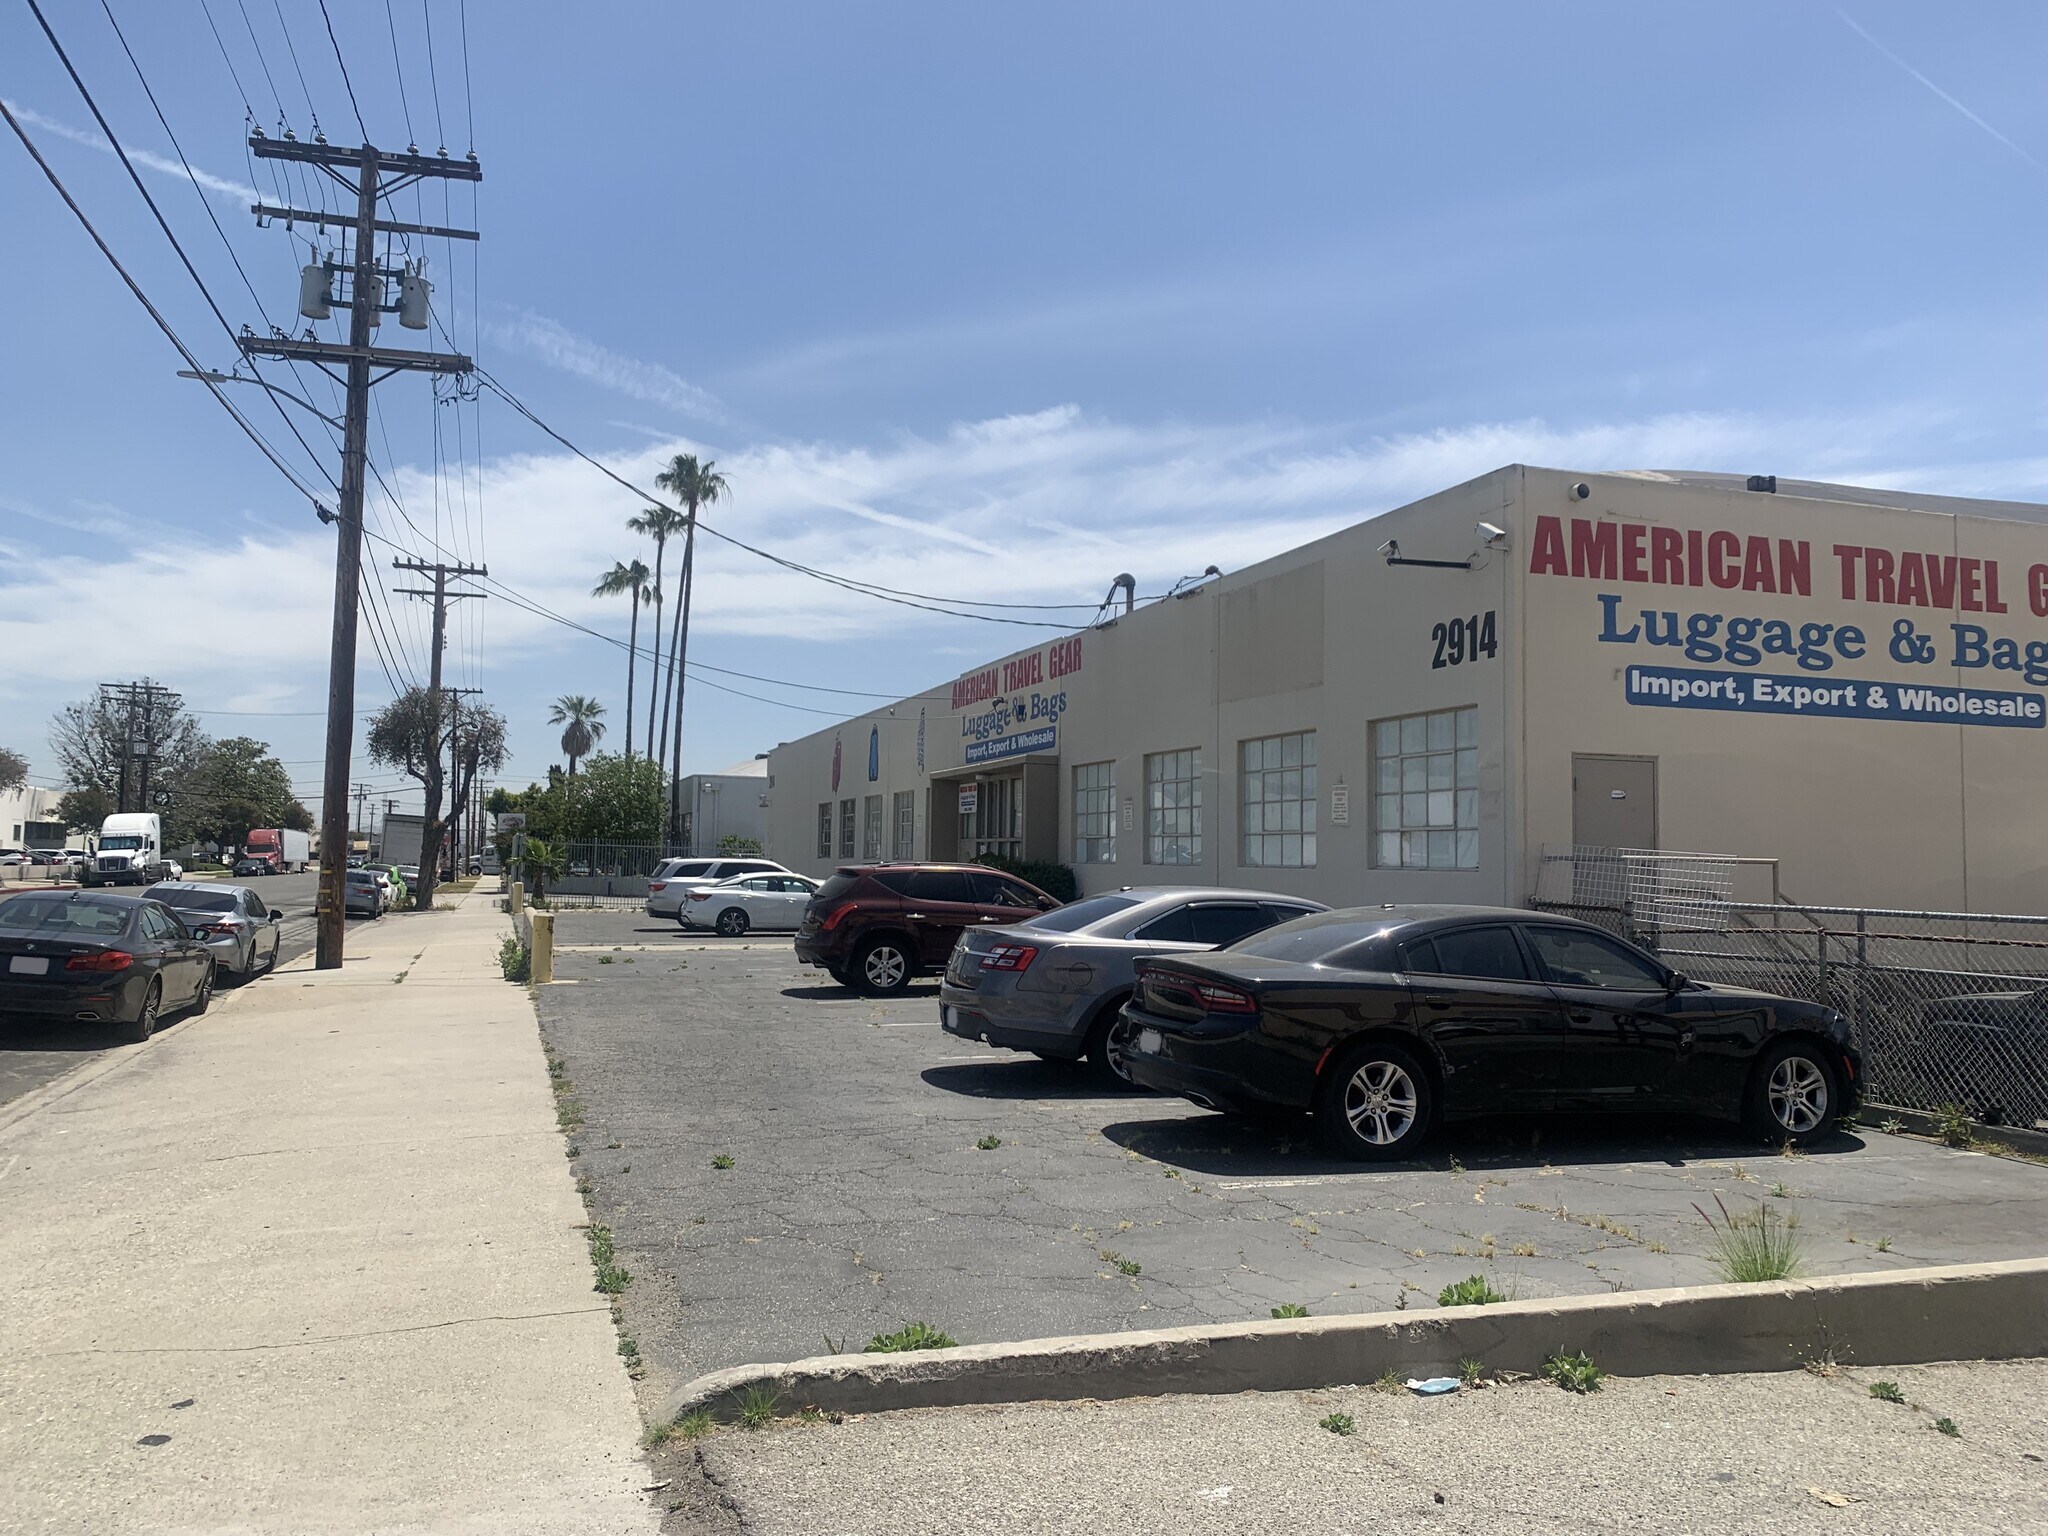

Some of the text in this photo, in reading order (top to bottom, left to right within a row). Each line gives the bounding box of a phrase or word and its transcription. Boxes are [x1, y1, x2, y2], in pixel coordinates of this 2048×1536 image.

[1529, 515, 1812, 597] AMERICAN
[1833, 544, 2008, 614] TRAVEL
[1431, 610, 1498, 670] 2914
[1597, 594, 1866, 671] Luggage
[1889, 619, 1936, 664] &
[951, 637, 1082, 711] AMERICAN TRAVEL GEAR
[1631, 670, 2041, 719] Import, Export & Wholesale
[962, 708, 1011, 740] Luggage
[1030, 692, 1067, 723] Bags
[967, 729, 1054, 760] Import, Export & Wholesale
